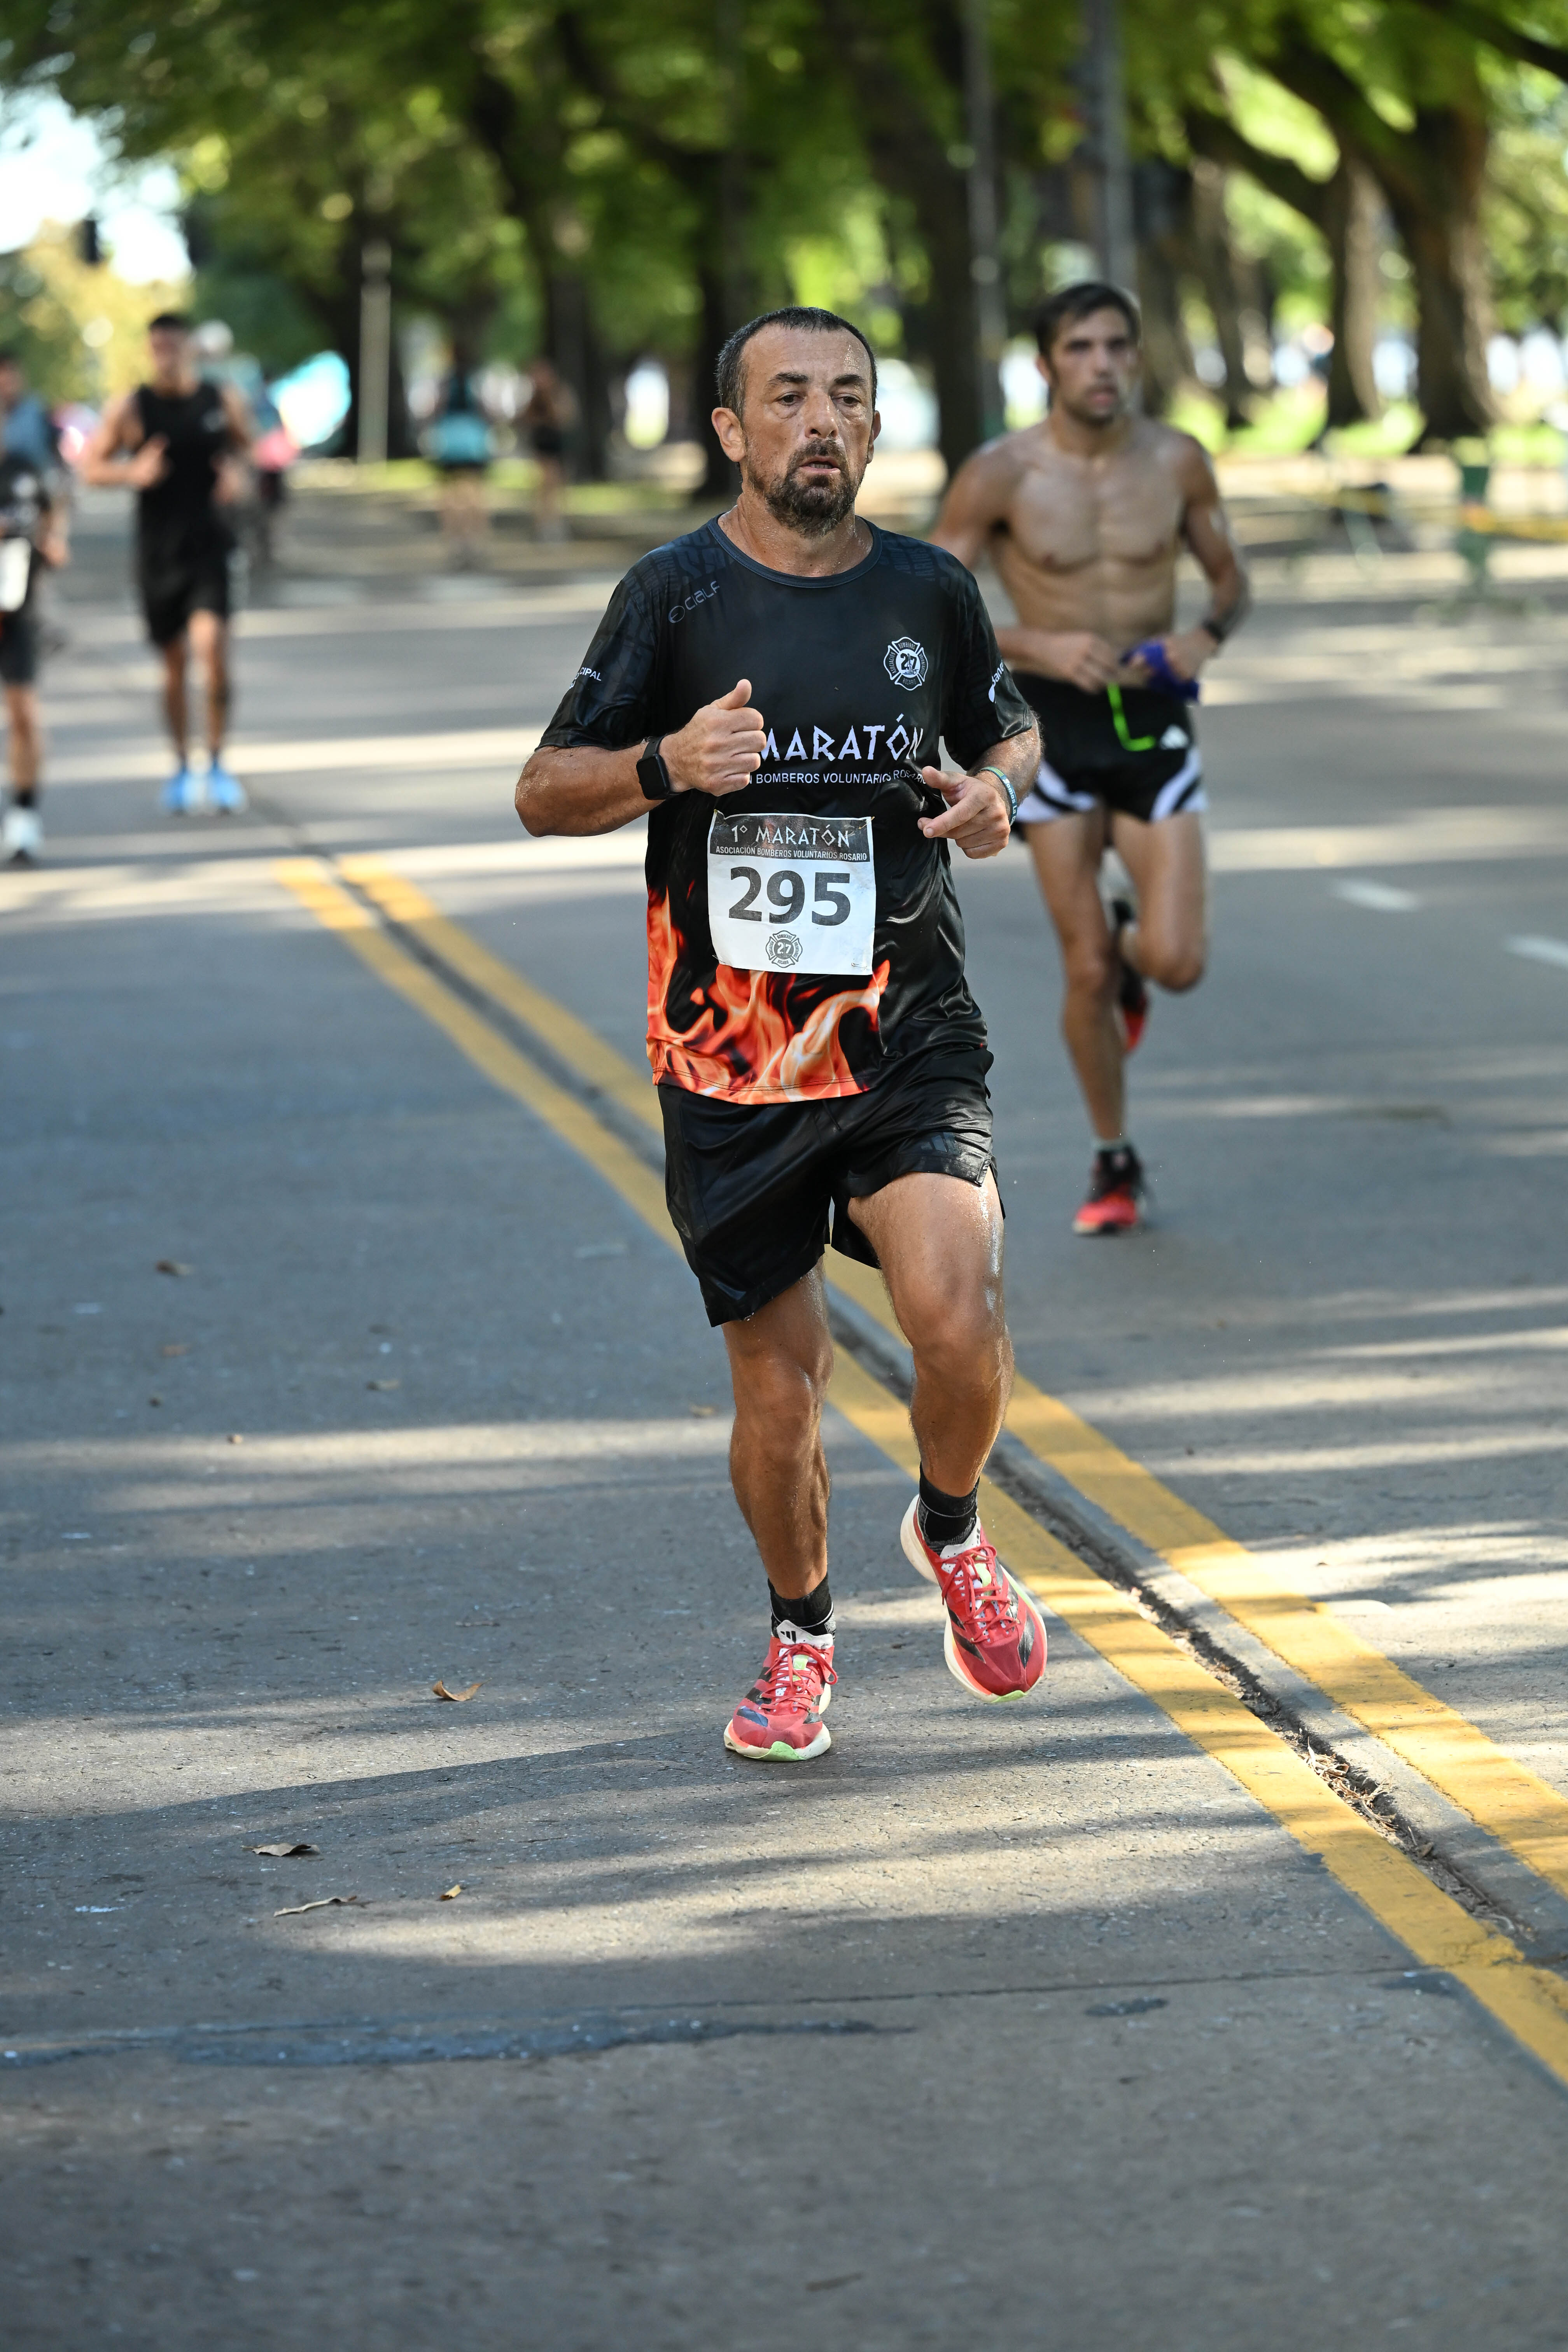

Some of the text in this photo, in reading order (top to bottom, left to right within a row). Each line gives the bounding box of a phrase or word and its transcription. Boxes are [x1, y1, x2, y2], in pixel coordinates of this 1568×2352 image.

[900, 653, 917, 670] 27
[756, 773, 819, 784] BOMBEROS
[823, 772, 891, 784] VOLUNTARIOS
[756, 824, 849, 848] MARATÓN
[716, 845, 867, 861] ASOCIACIÓN BOMBEROS VOLUNTARIOS ROSARIO
[728, 866, 851, 926] 295
[777, 942, 791, 954] 27
